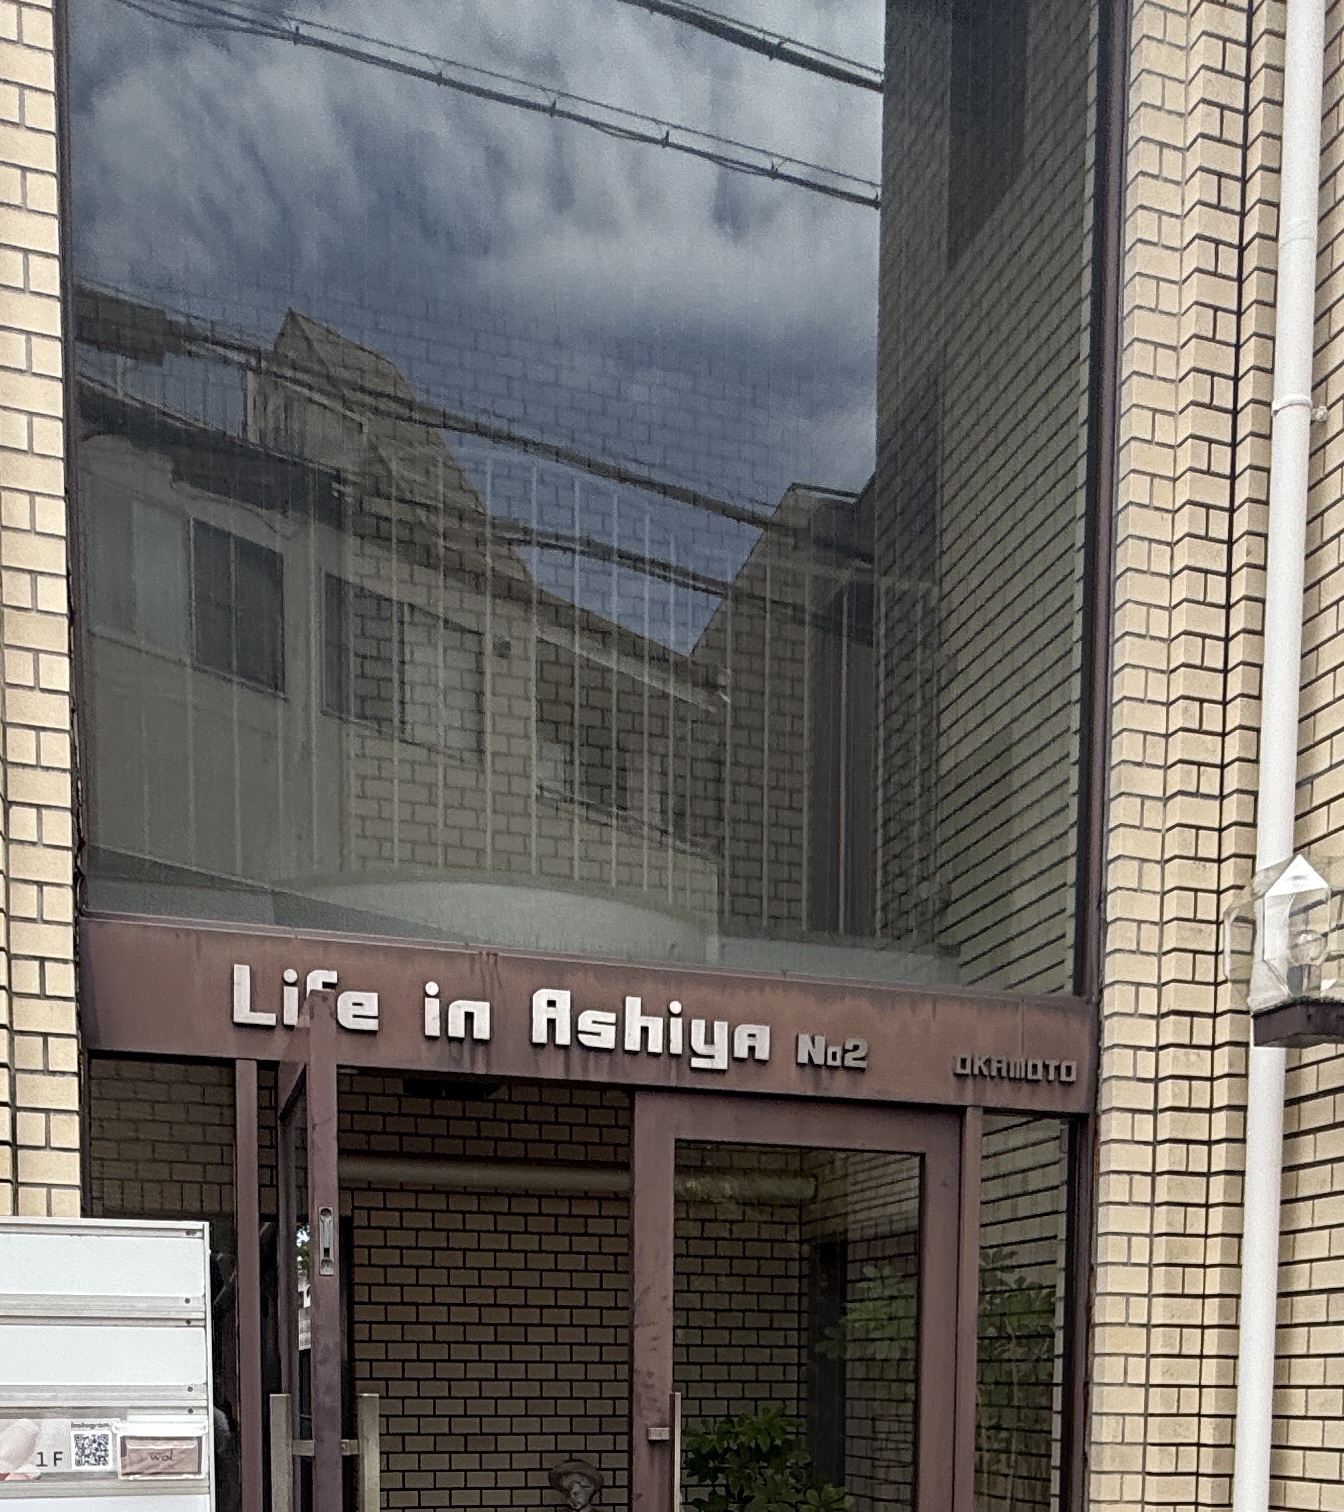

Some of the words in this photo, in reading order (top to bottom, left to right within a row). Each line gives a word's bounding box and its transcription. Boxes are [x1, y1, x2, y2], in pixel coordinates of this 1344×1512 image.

[424, 981, 491, 1041] in
[531, 988, 771, 1070] Ashiya
[953, 1053, 1077, 1083] OKAMOTO
[36, 1451, 63, 1467] 1F
